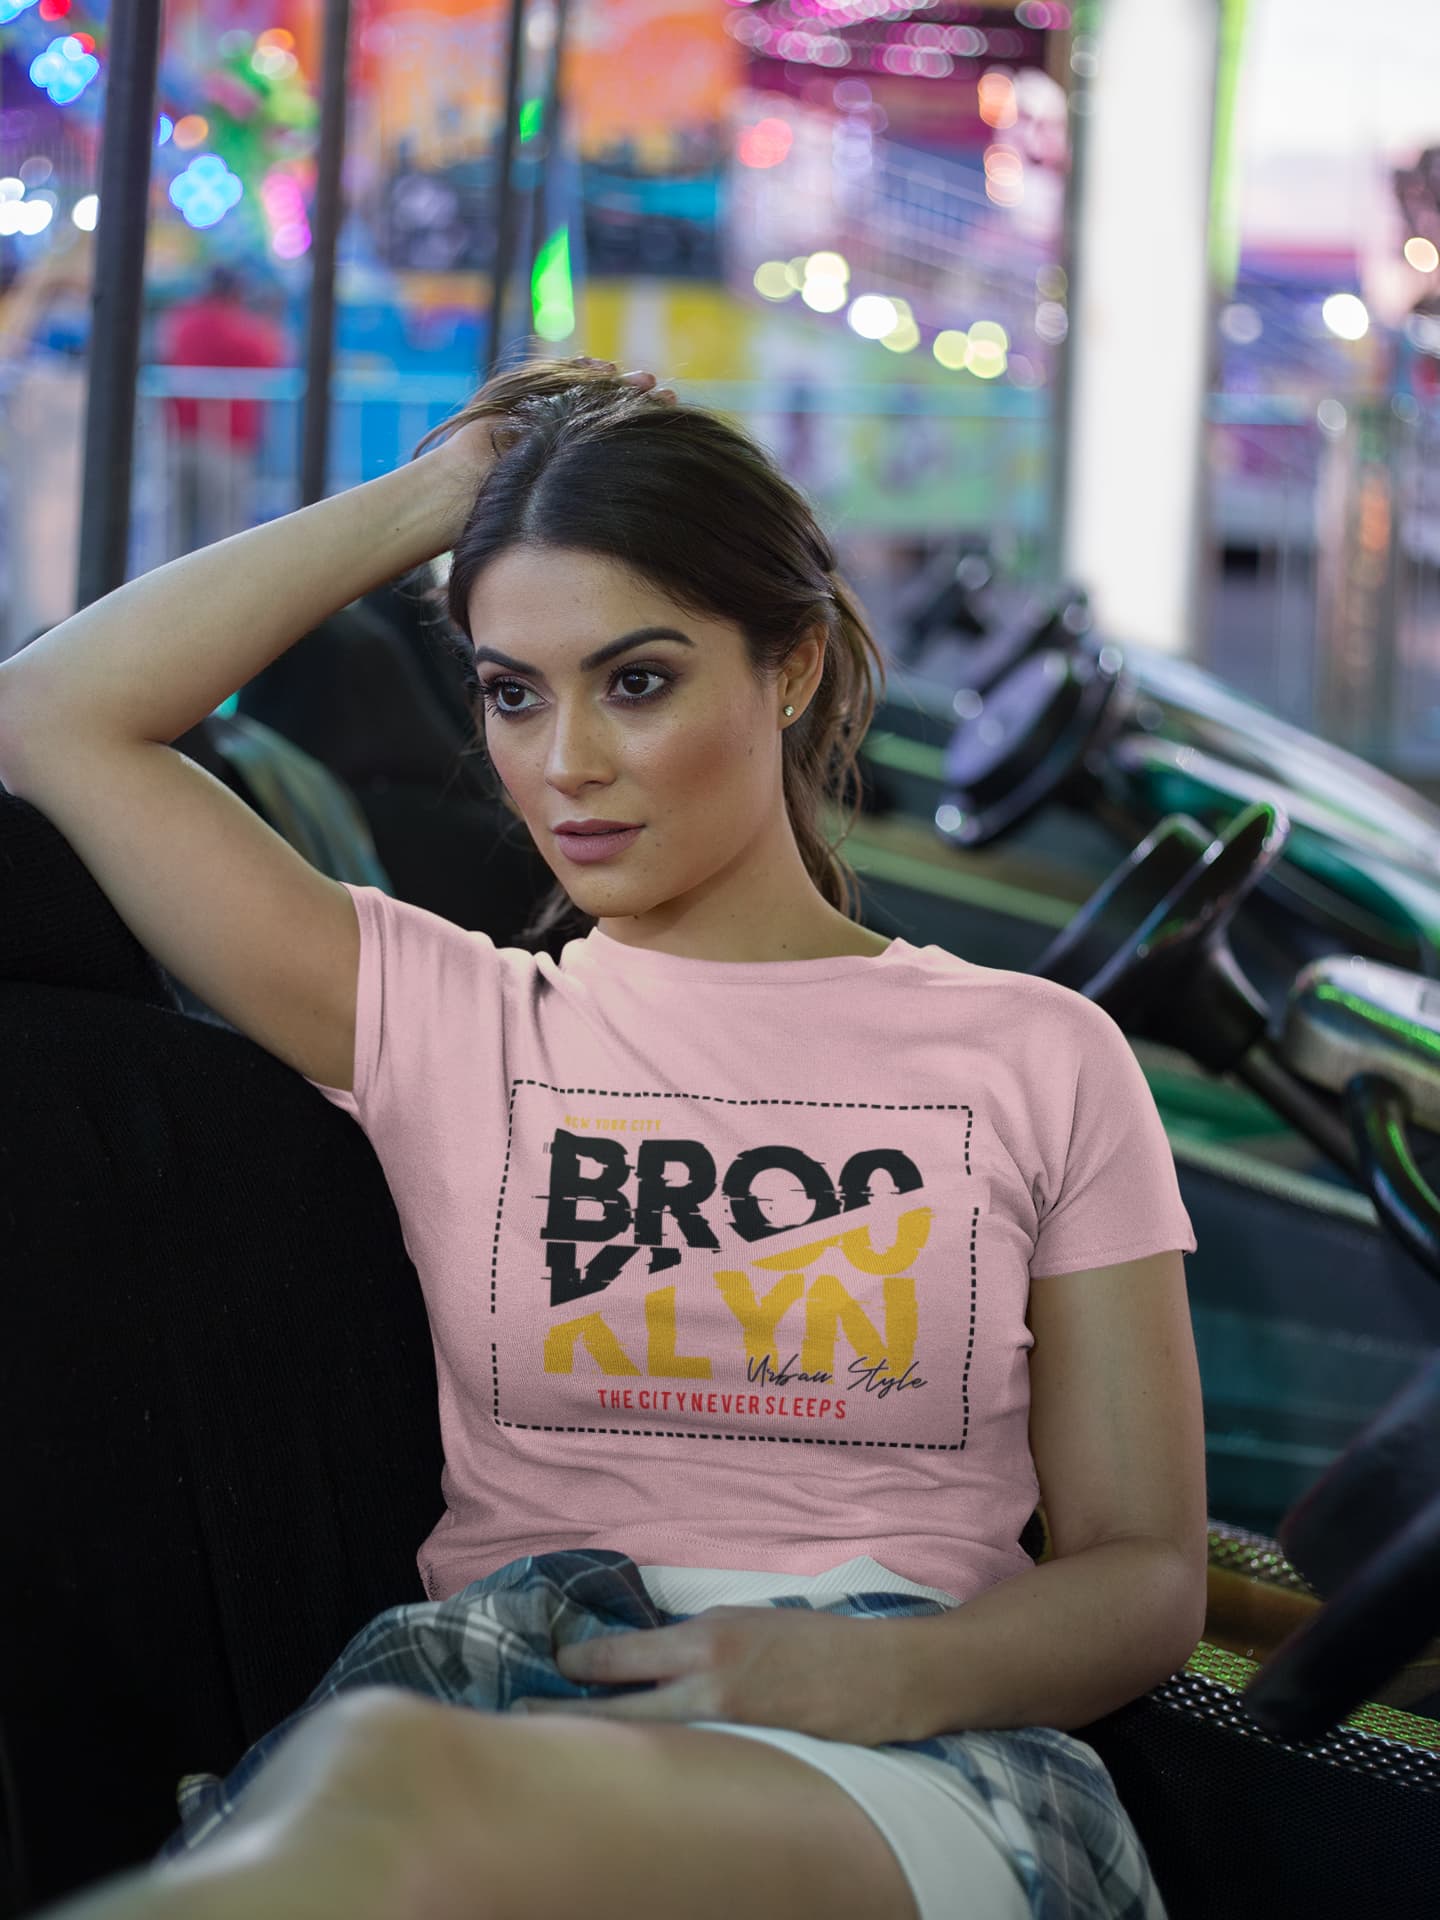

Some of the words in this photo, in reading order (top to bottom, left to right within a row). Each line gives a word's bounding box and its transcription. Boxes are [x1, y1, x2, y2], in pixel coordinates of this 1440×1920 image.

[630, 1119, 662, 1132] CITY
[747, 1353, 833, 1388] Urban
[847, 1356, 928, 1399] Style
